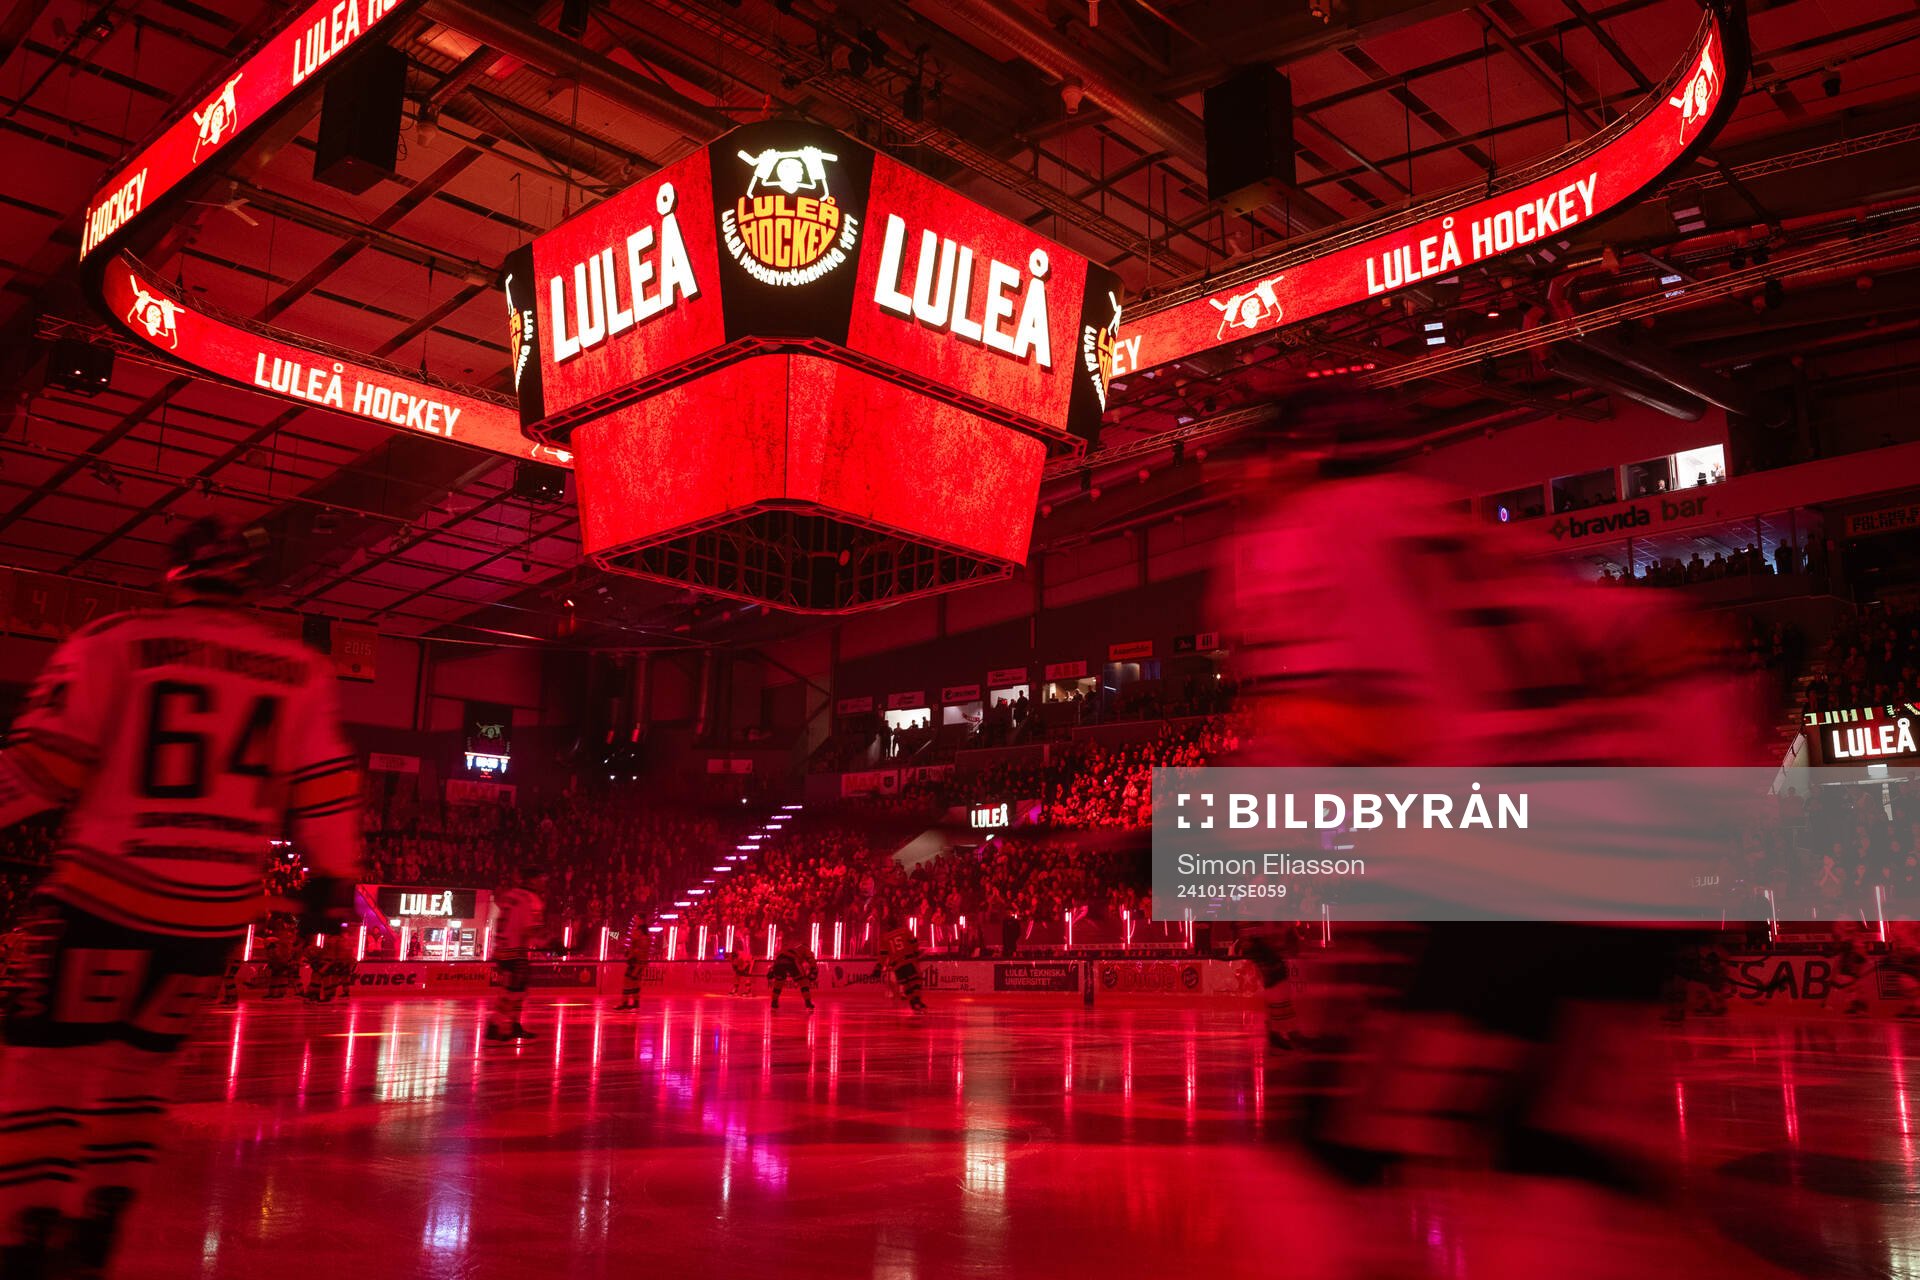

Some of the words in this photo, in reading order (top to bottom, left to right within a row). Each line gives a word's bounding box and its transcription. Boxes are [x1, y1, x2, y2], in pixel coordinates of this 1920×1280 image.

[88, 167, 148, 251] HOCKEY
[738, 195, 840, 229] LULEÅ
[1366, 216, 1463, 295] LULEÅ
[1471, 172, 1598, 261] HOCKEY
[739, 217, 837, 268] HOCKEY
[550, 182, 698, 363] LULEÅ
[873, 212, 1052, 369] LULEÅ
[254, 351, 345, 409] LULEÅ
[352, 380, 461, 437] HOCKEY
[1569, 505, 1651, 538] bravida
[1660, 495, 1709, 522] bar
[143, 678, 284, 799] 64
[1831, 717, 1917, 759] LULEÅ
[971, 802, 1009, 829] LULEÅ
[399, 889, 453, 916] LULEÅ
[350, 970, 417, 986] ranec
